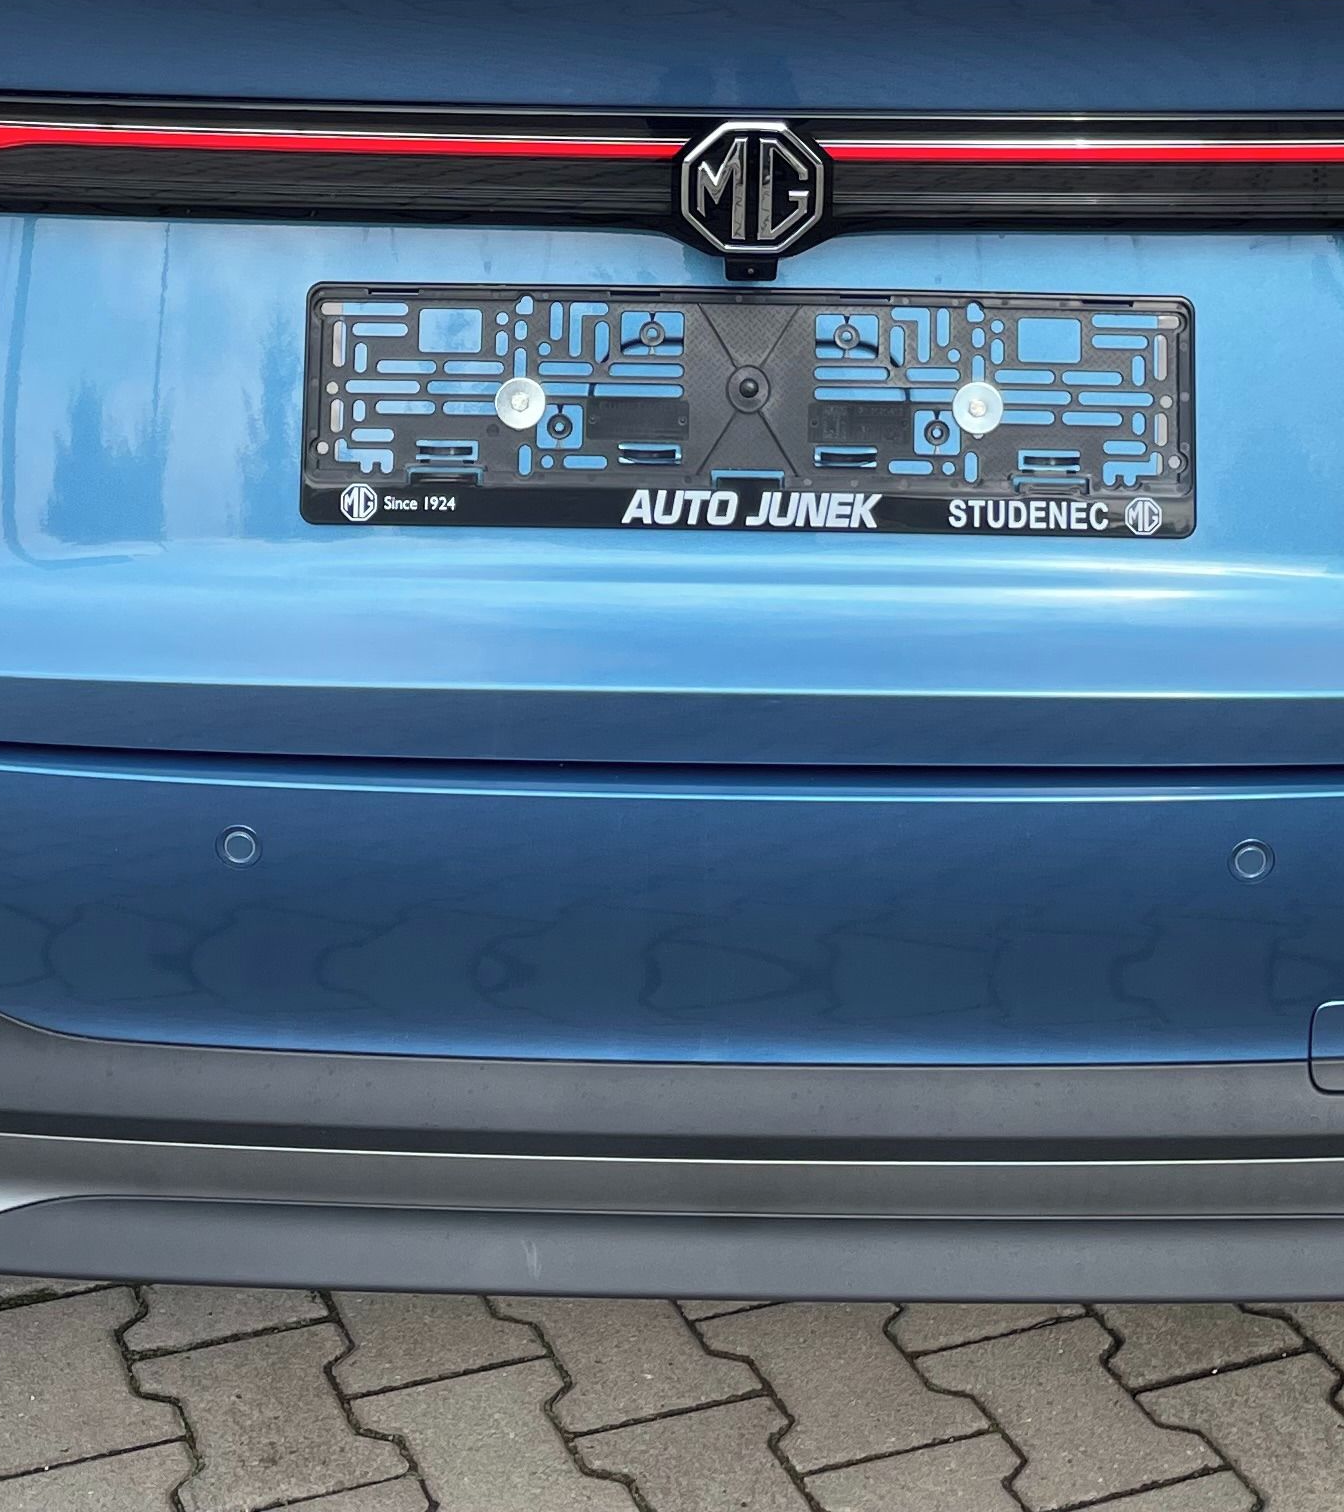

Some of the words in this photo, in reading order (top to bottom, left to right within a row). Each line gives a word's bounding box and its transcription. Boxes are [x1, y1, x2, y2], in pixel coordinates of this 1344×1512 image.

[695, 133, 812, 242] MG
[342, 486, 376, 519] MG
[383, 496, 418, 511] Since
[424, 496, 456, 511] 1924
[621, 489, 739, 526] AUTO
[745, 491, 883, 529] JUNEK
[948, 499, 1109, 531] STUDENEC
[1127, 500, 1160, 532] MG
